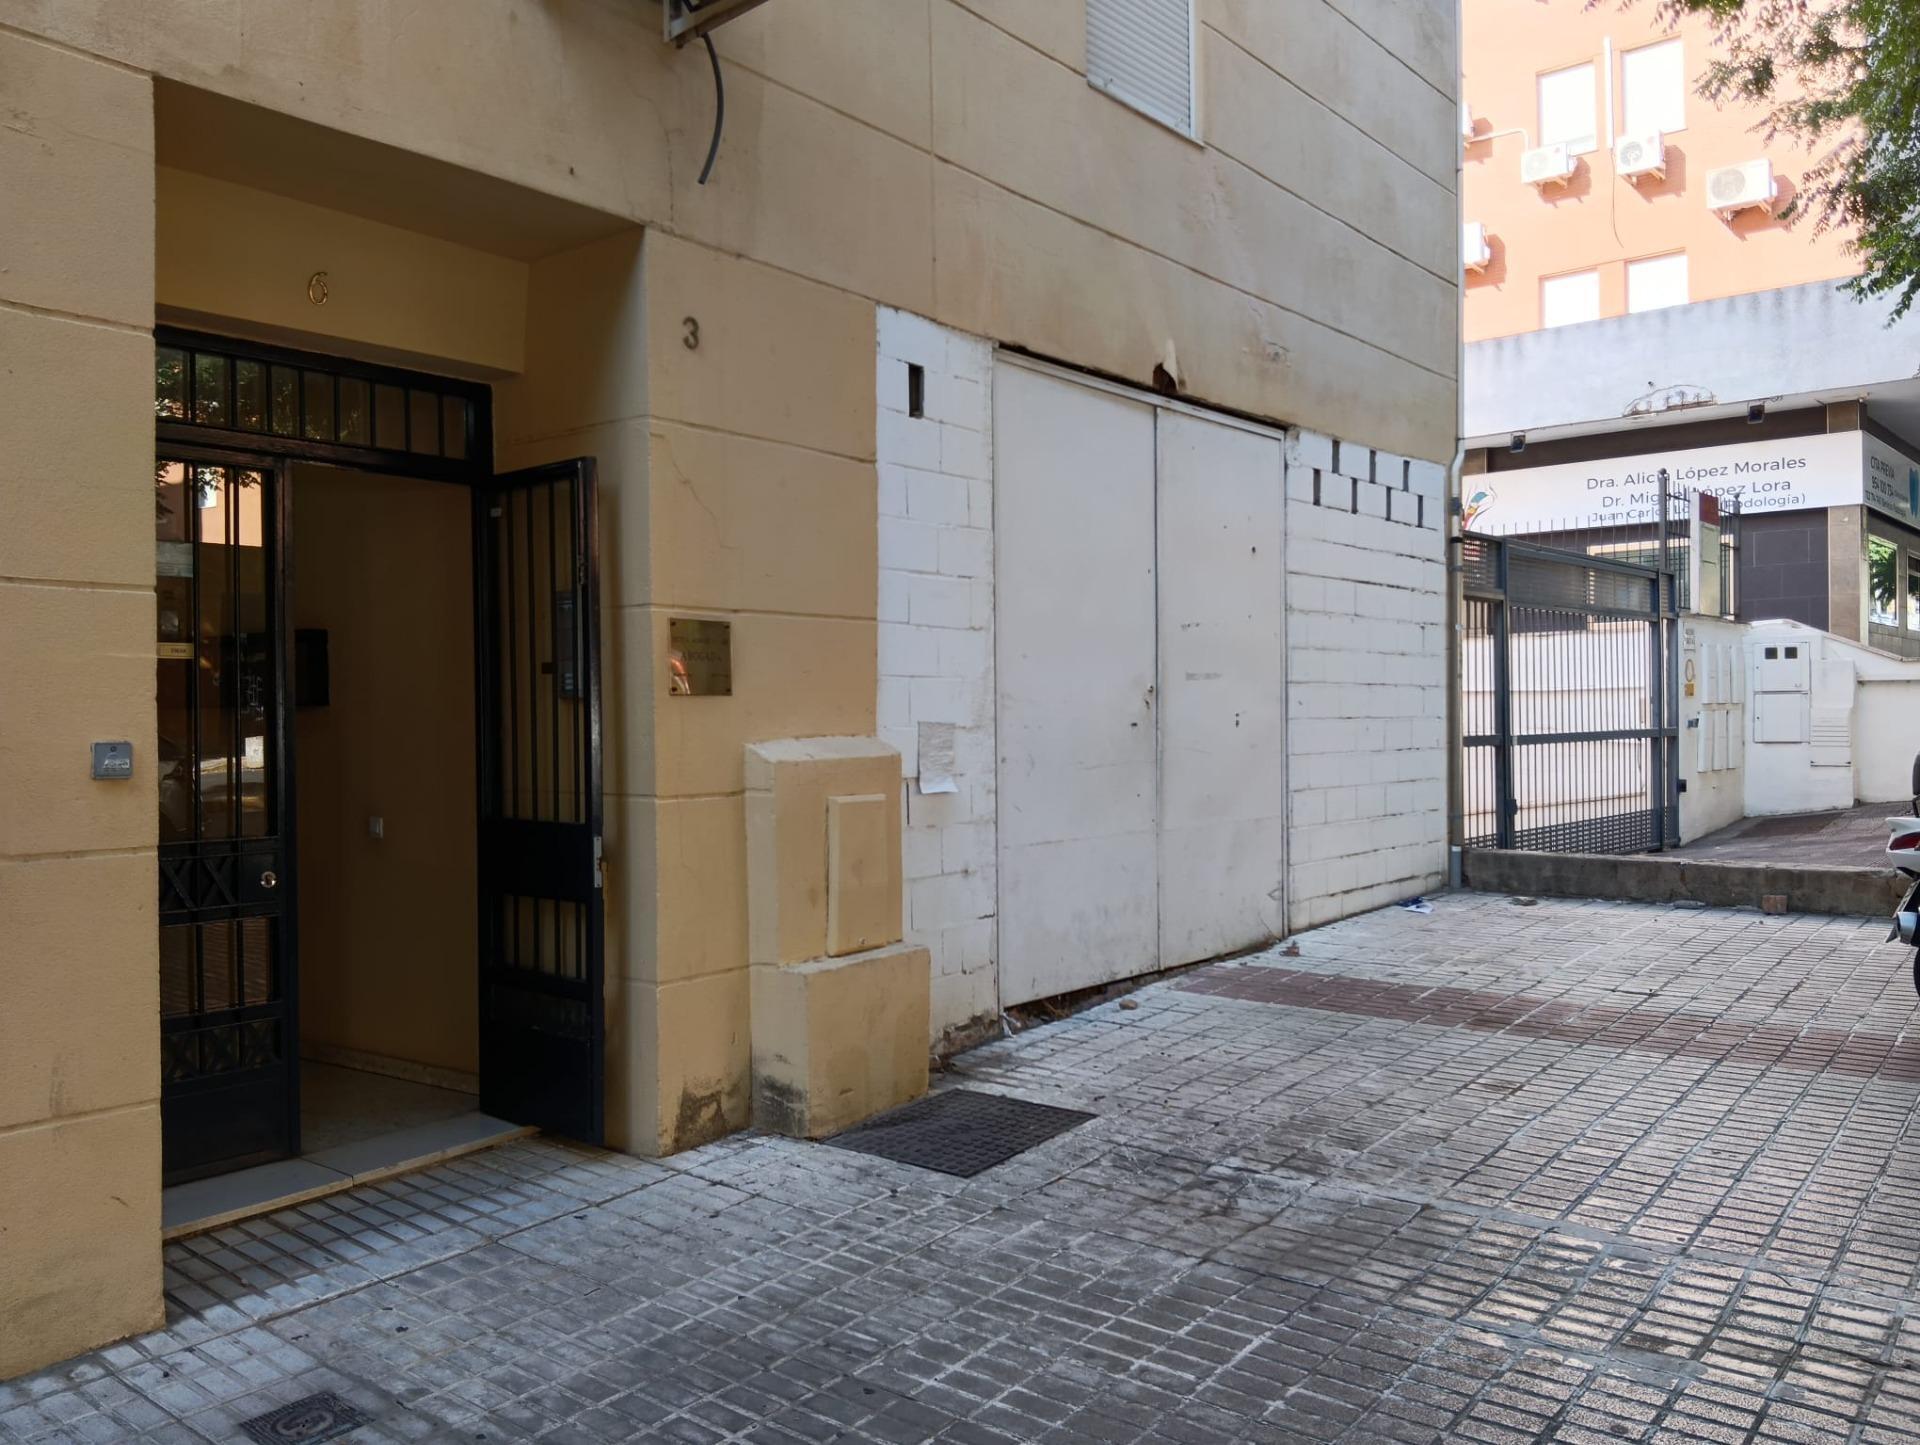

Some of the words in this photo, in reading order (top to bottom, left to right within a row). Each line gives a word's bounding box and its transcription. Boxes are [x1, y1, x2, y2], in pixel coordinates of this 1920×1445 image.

[308, 271, 328, 305] 6
[682, 316, 700, 350] 3
[1586, 477, 1618, 490] Dra.
[1624, 471, 1670, 486] Alica
[1676, 466, 1728, 481] López
[1734, 457, 1807, 474] Morales
[1602, 496, 1624, 508] Dr.
[1630, 488, 1687, 507] Migel
[1694, 485, 1746, 498] ópez
[1752, 480, 1791, 494] Lora
[1592, 511, 1624, 522] Juan
